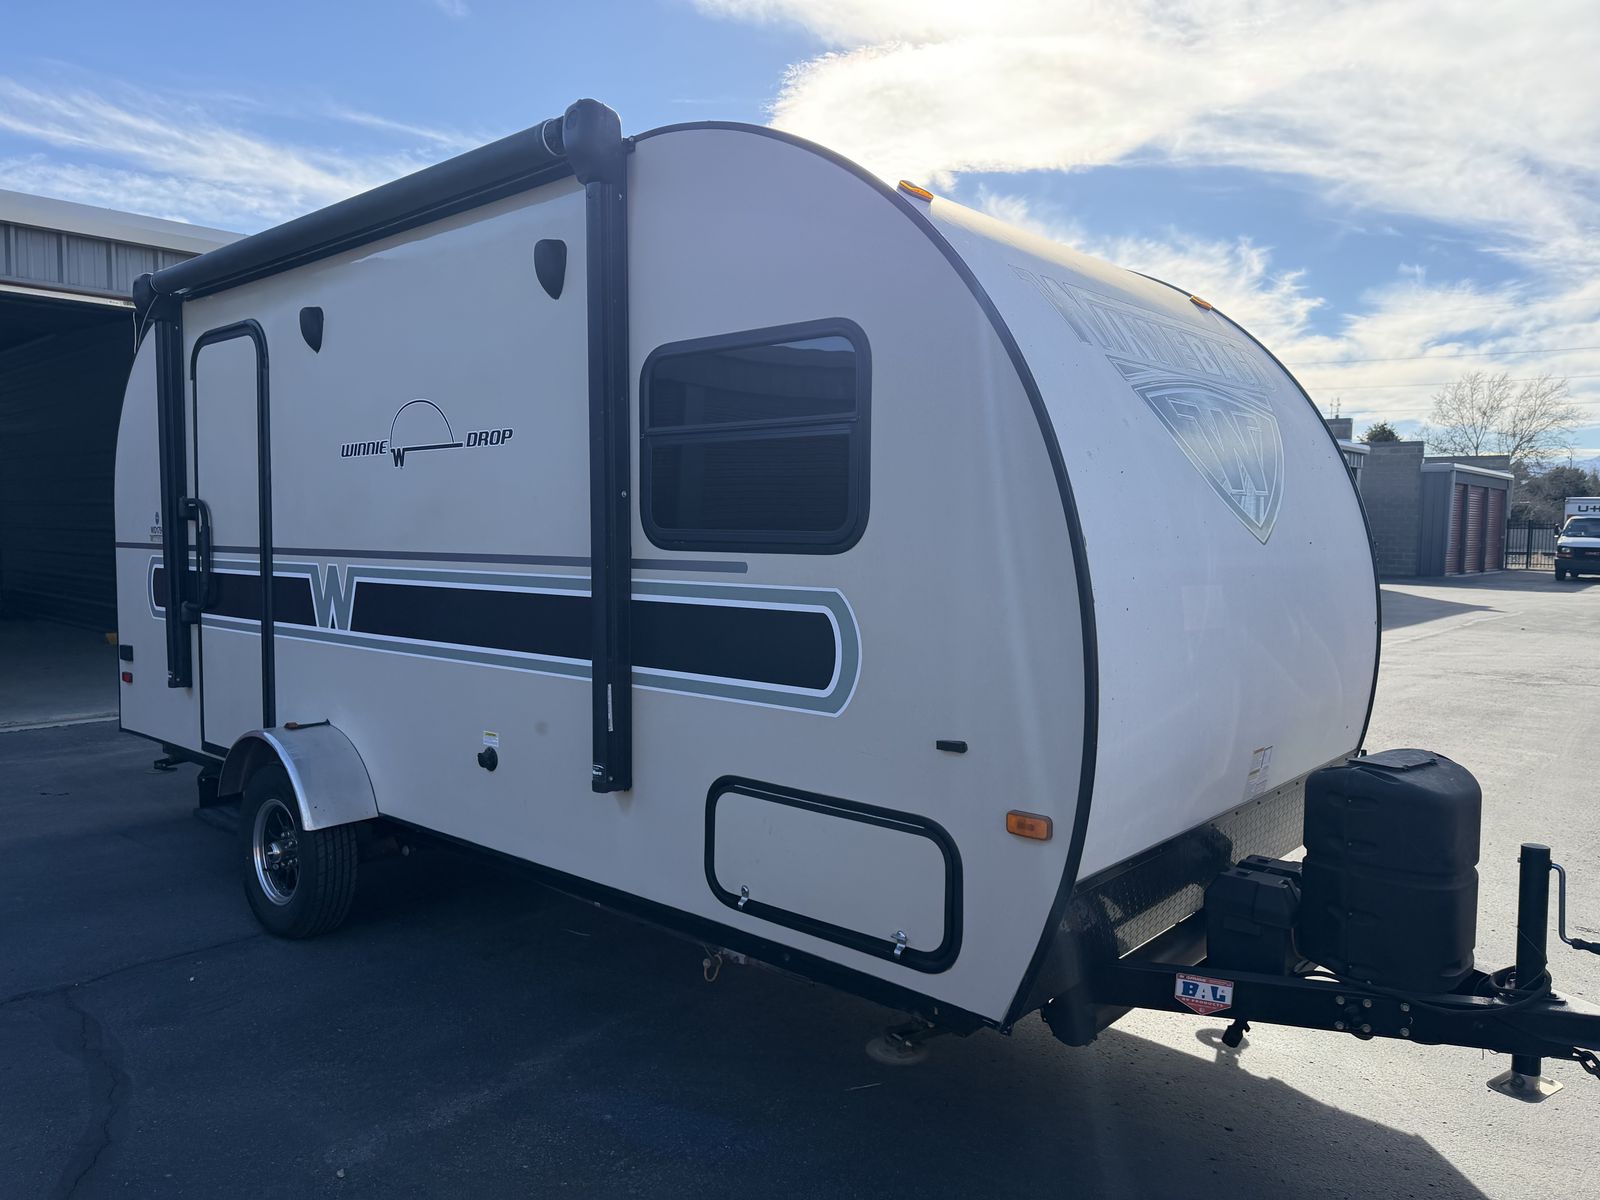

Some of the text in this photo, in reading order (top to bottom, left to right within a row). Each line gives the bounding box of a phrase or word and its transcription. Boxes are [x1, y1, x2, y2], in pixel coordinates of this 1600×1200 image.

[341, 428, 514, 458] WINNIE DROP
[1181, 980, 1226, 1003] BAL
